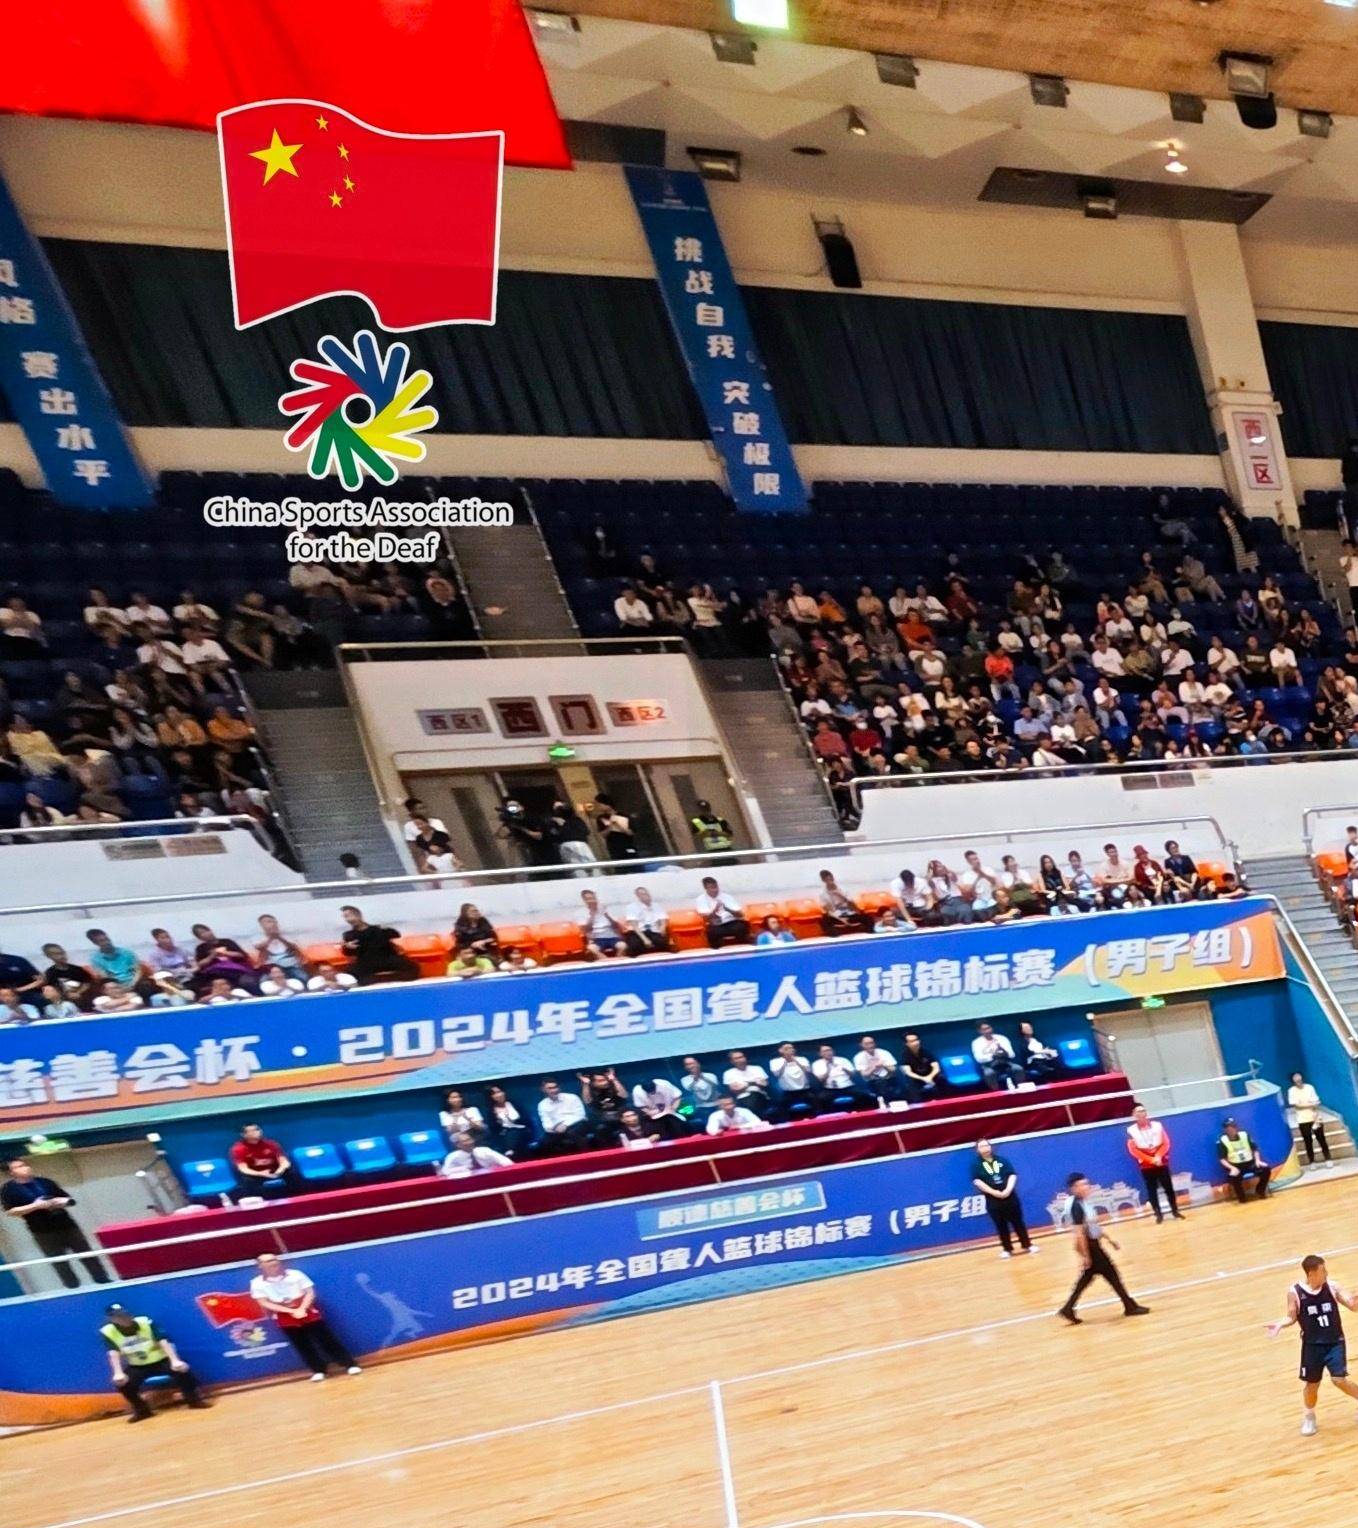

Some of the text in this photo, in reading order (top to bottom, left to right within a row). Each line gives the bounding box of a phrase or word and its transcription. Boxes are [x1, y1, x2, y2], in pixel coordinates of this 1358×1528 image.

[673, 236, 781, 496] 挑战自我 突破极限
[20, 350, 112, 487] 赛出水平
[496, 701, 597, 733] 西门
[615, 706, 666, 721] 西区2
[658, 1186, 807, 1230] 顺德慈善会杯
[453, 1194, 987, 1309] 2024年全国聋人篮球锦标赛（男子组
[1317, 1315, 1329, 1327] 11
